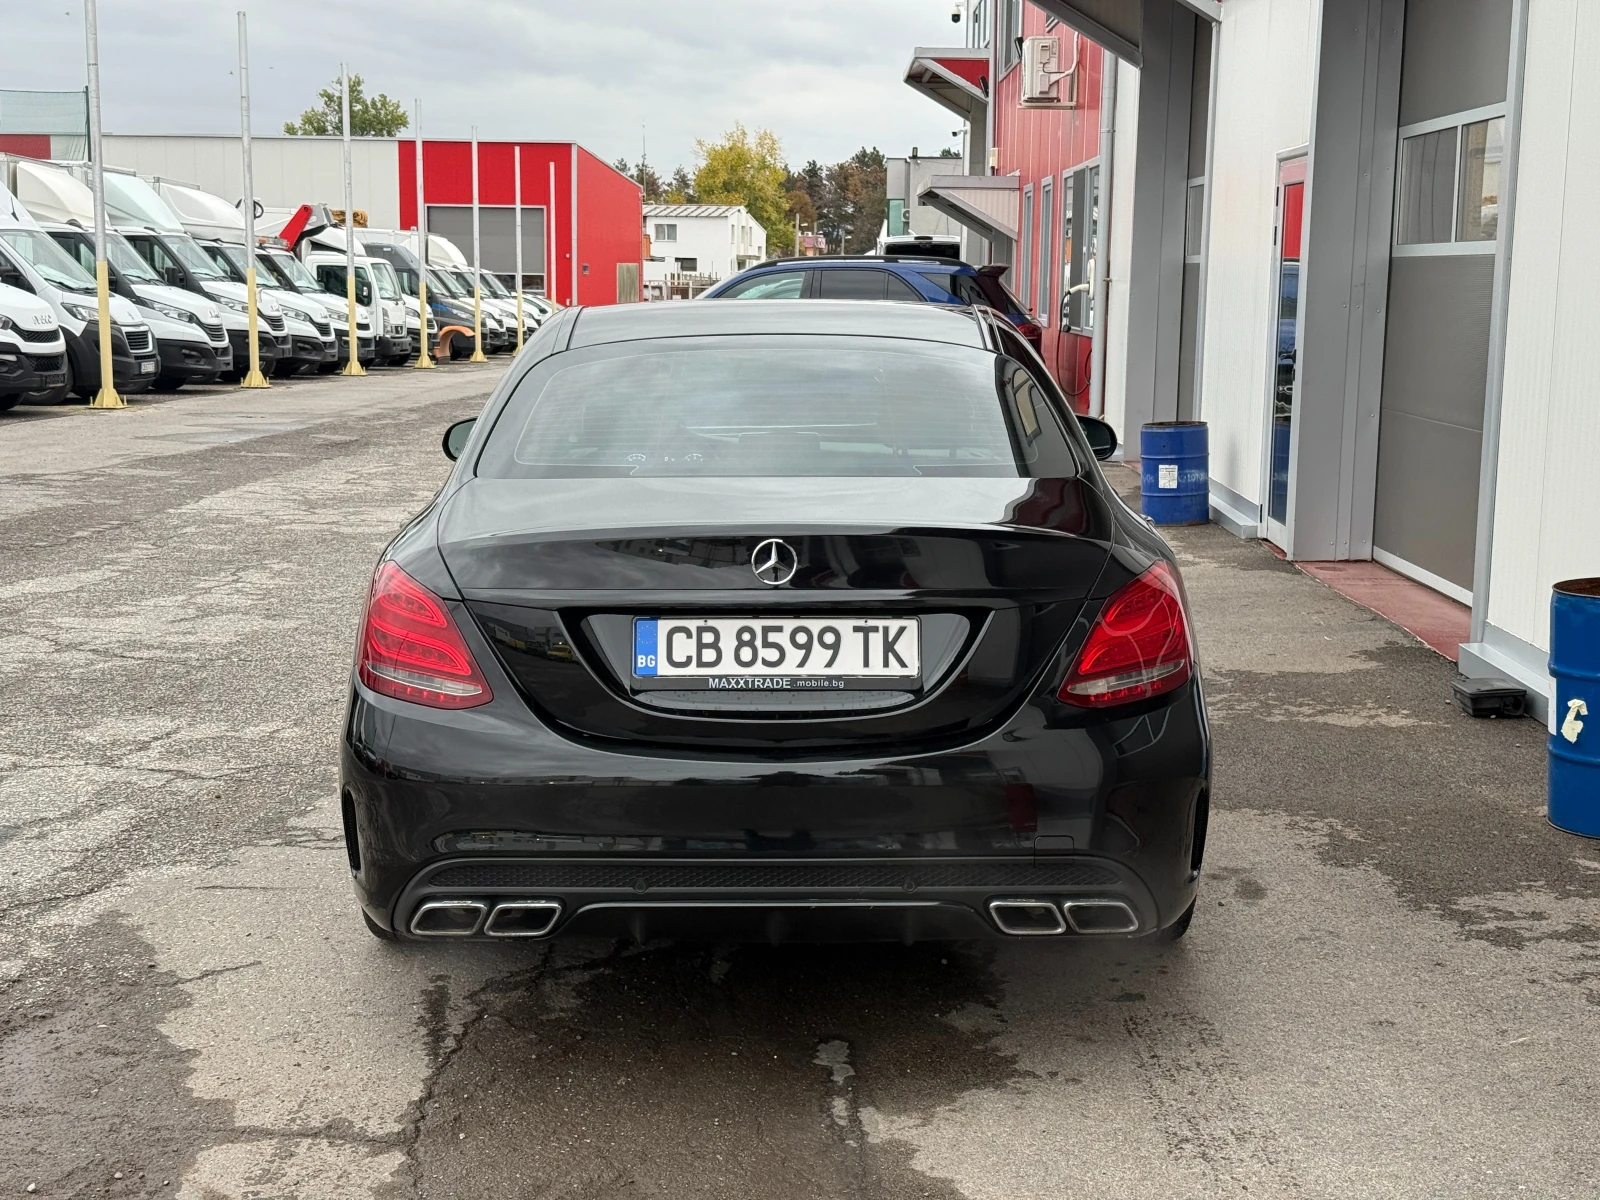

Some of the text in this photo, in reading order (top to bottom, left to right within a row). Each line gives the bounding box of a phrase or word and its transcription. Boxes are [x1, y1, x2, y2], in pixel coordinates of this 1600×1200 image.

[666, 626, 909, 668] CB 8599 TK
[637, 654, 656, 668] BG
[708, 678, 791, 689] MAXXTRADE
